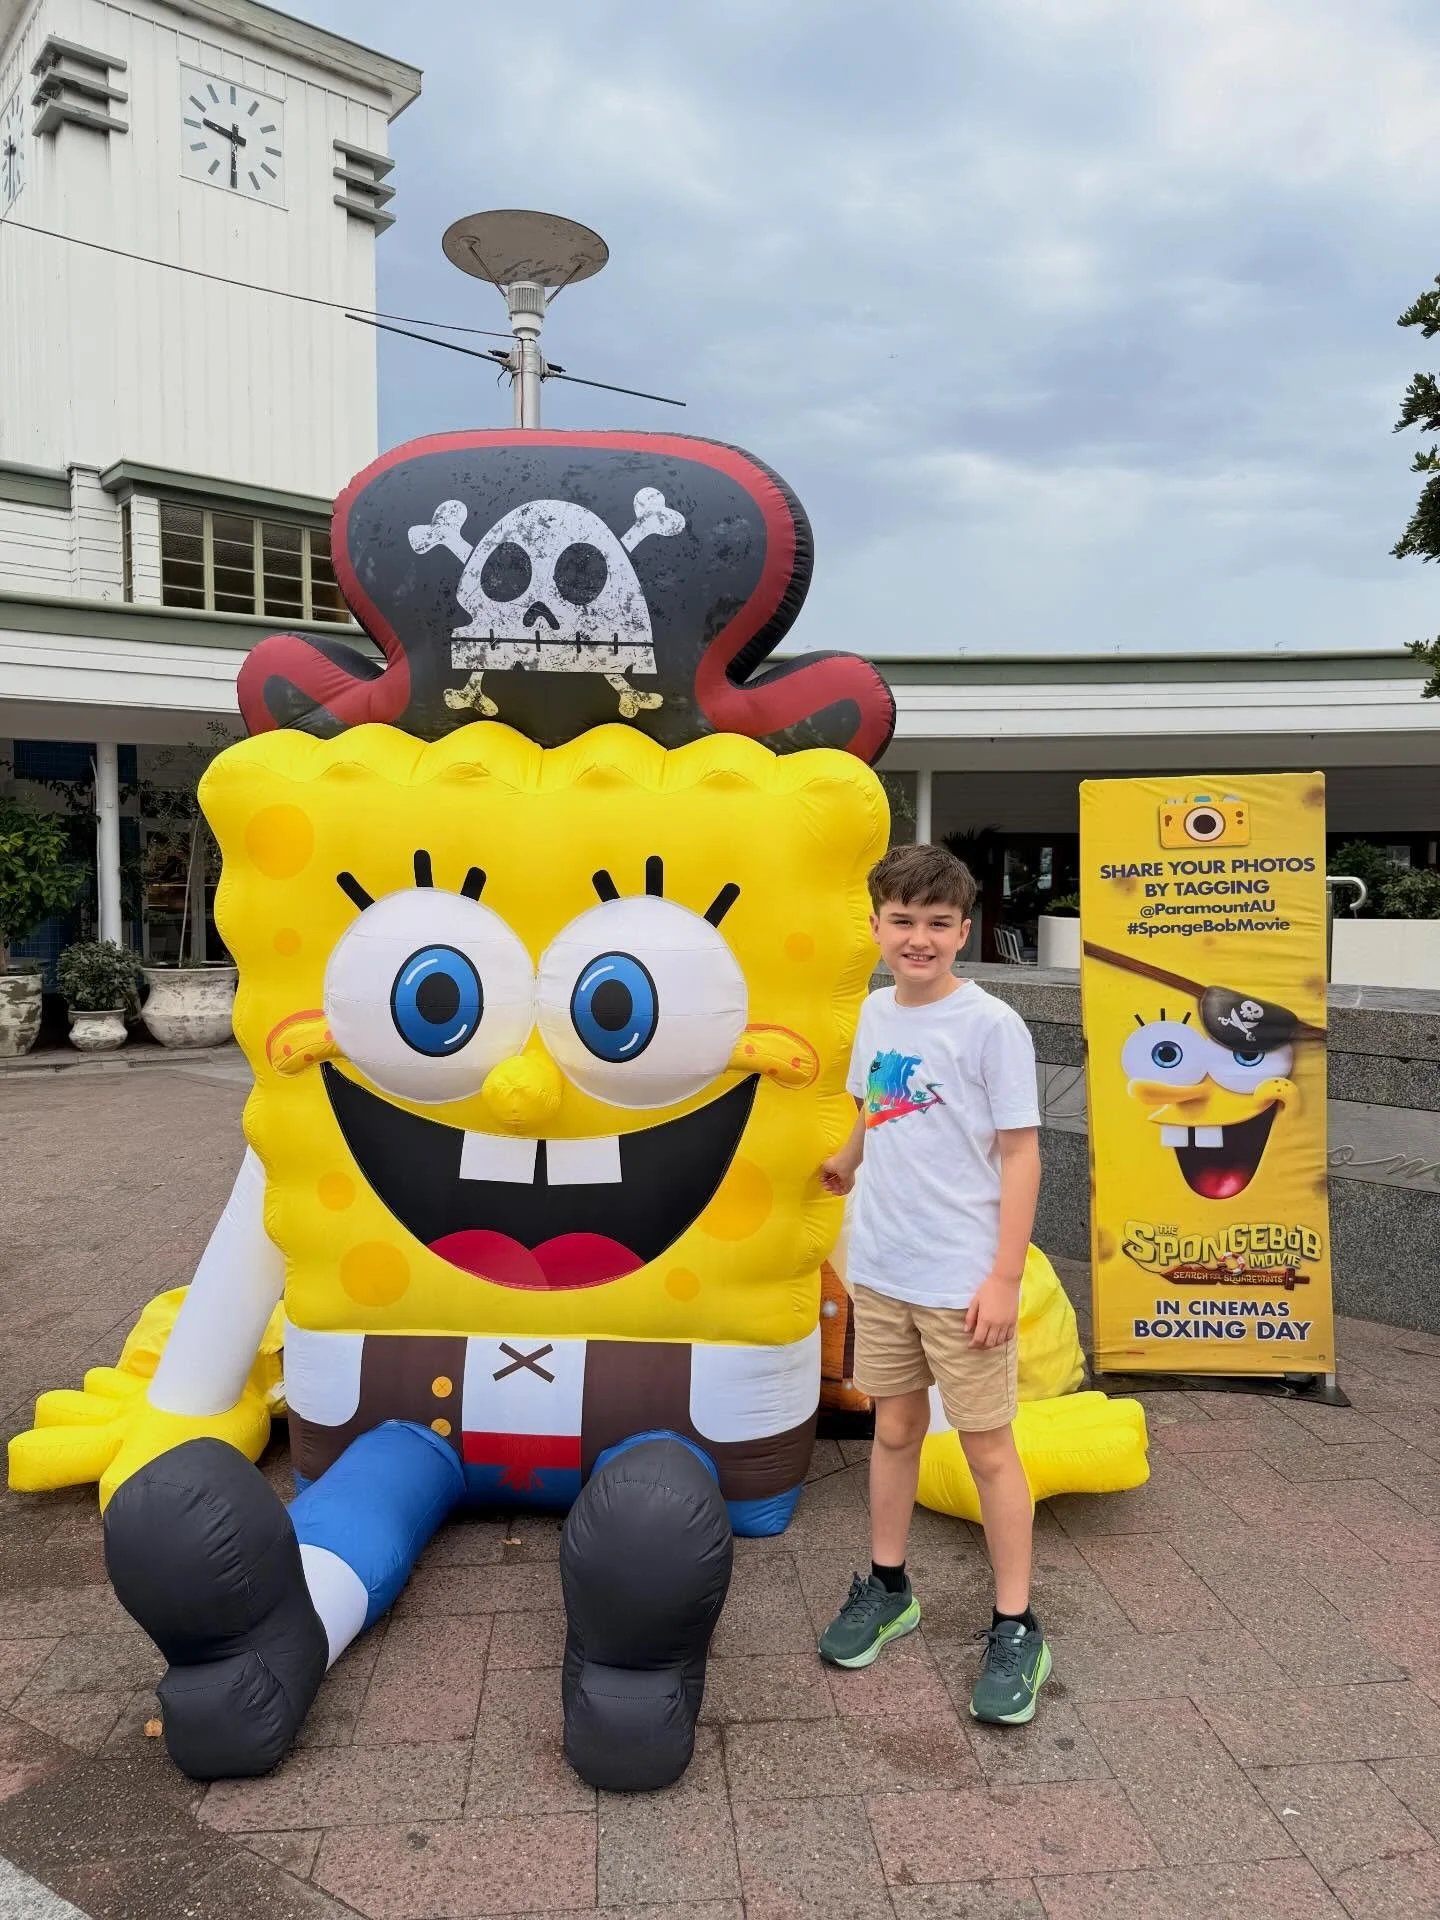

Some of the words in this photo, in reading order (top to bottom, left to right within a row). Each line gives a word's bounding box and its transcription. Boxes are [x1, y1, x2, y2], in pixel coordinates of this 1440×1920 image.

[1100, 862, 1163, 879] SHARE
[1168, 860, 1225, 875] YOUR
[1231, 857, 1316, 874] PHOTOS
[1144, 883, 1169, 898] BY
[1173, 879, 1270, 896] TAGGING
[1140, 899, 1275, 918] @ParamountAU
[1127, 917, 1290, 937] #SpongeBobMovie
[1158, 1224, 1178, 1236] THE
[1249, 1252, 1302, 1269] MOVIE
[1173, 1271, 1208, 1280] SEARCH
[1156, 1300, 1180, 1315] IN
[1188, 1300, 1290, 1317] CINEMAS
[1134, 1320, 1246, 1339] BOXING
[1256, 1321, 1312, 1341] DAY
